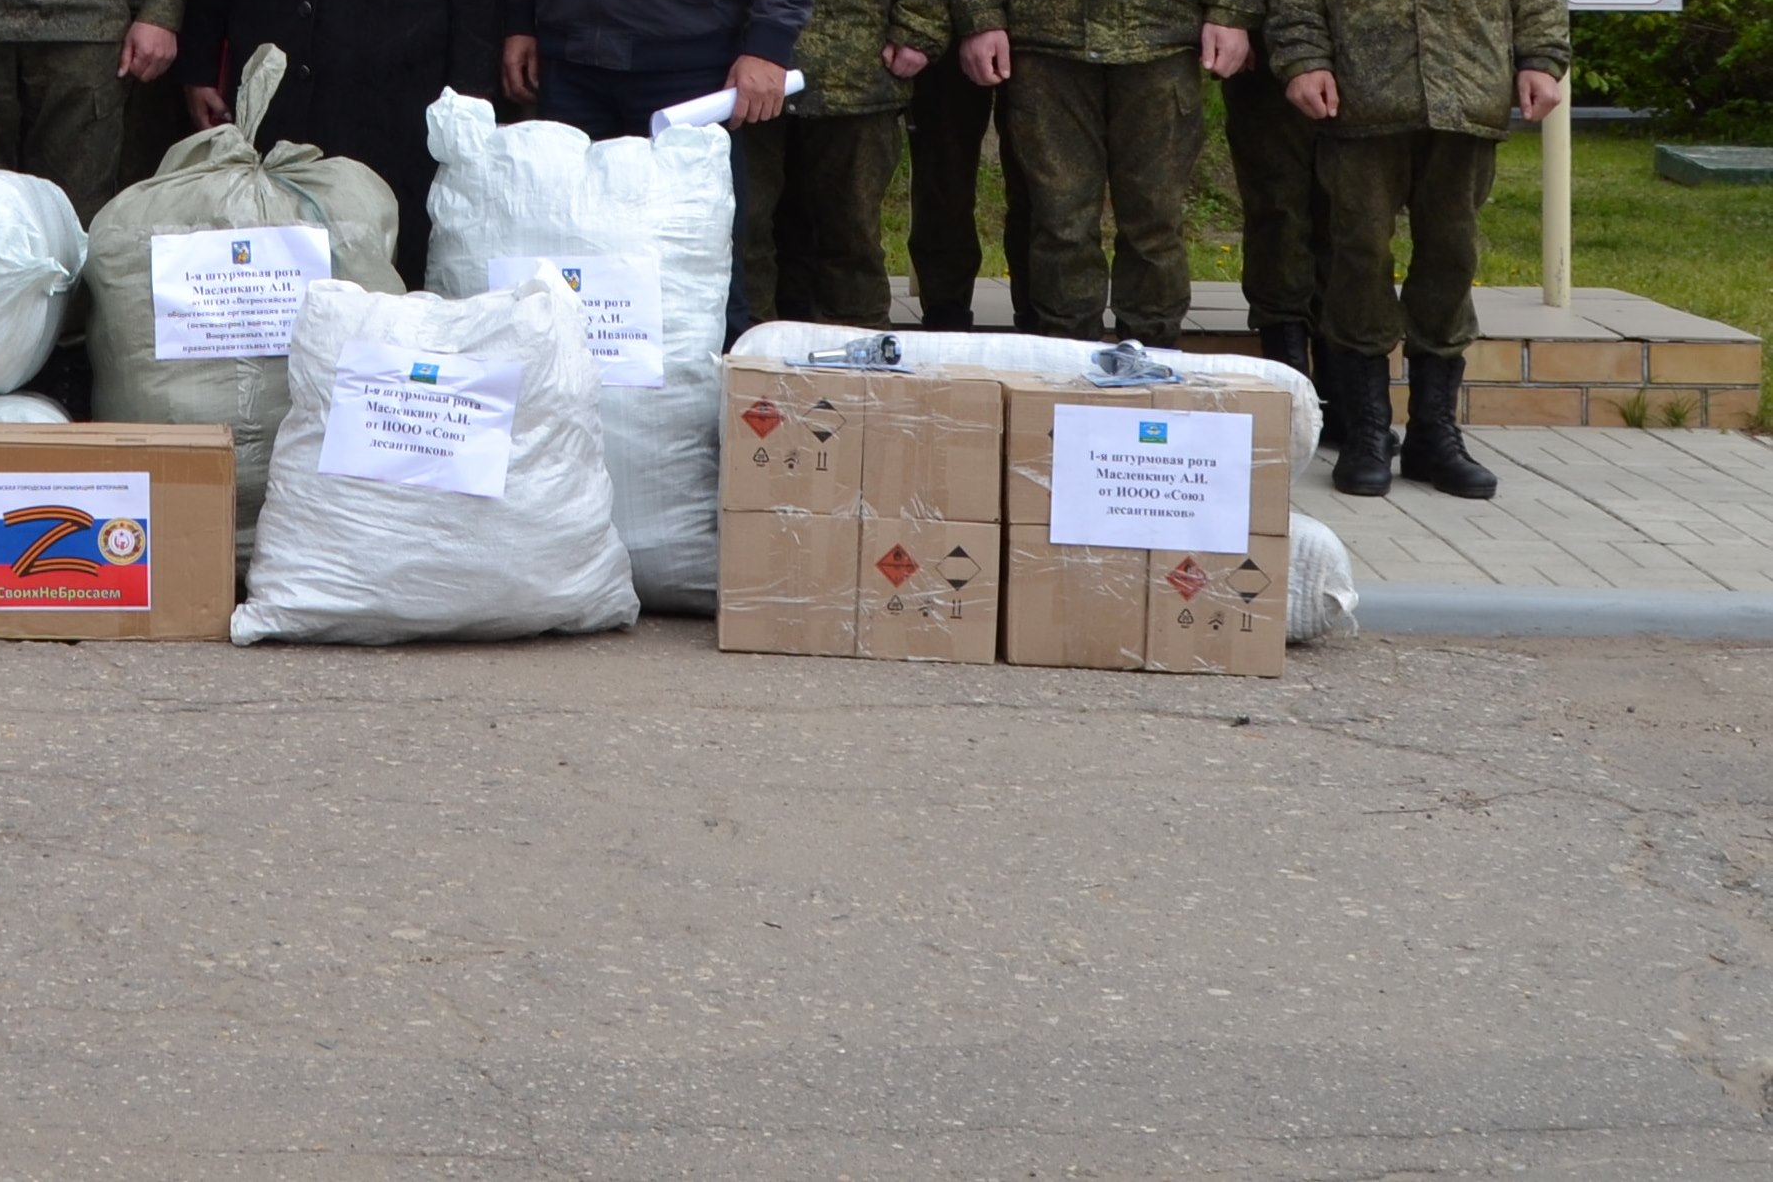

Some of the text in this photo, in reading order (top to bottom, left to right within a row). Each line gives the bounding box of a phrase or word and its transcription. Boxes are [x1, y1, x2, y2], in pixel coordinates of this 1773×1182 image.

[185, 269, 302, 283] 1-я штурмовая рота
[604, 299, 631, 309] рота
[597, 329, 648, 340] Иванова
[364, 384, 482, 410] 1-я штурмовая рота
[365, 420, 466, 442] от ИООО «Союз
[370, 438, 455, 458] десантников»
[1090, 449, 1217, 469] 1-я штурмовая рота
[1096, 468, 1209, 486] Масленкину А.И.
[1098, 486, 1205, 502] от ИООО «Союз
[1107, 505, 1196, 518] десантников»
